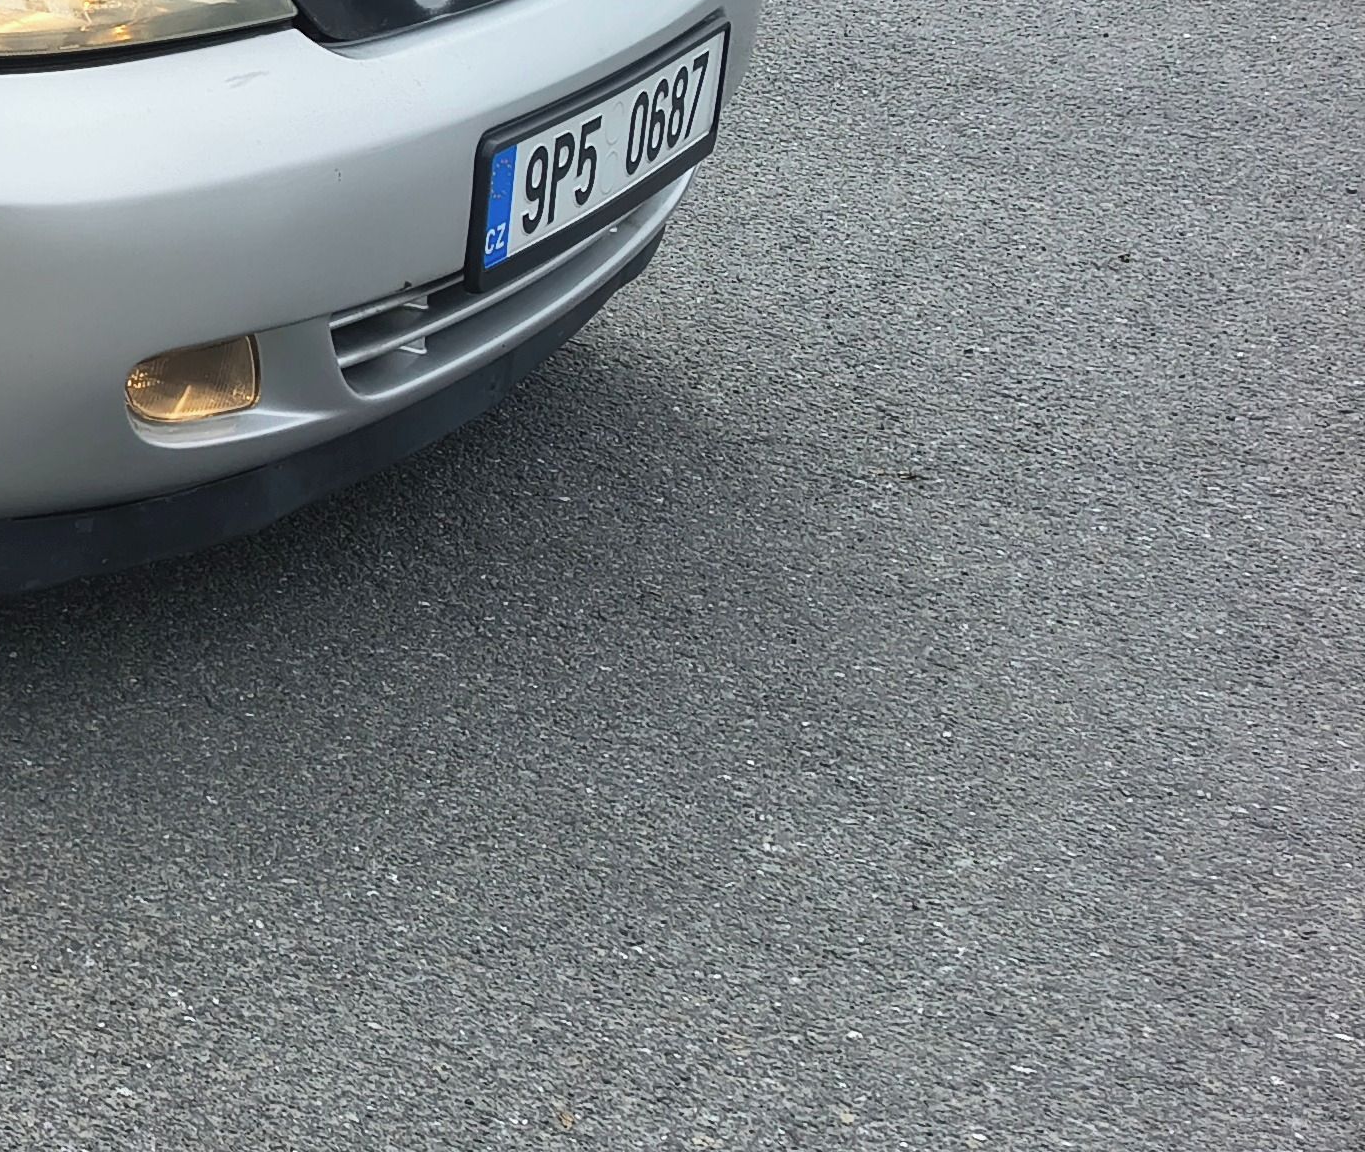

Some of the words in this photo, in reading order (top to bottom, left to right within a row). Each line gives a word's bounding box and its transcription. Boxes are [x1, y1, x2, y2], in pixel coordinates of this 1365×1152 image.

[522, 115, 603, 235] 9P5
[626, 50, 710, 176] 0687
[484, 222, 507, 255] CZ
